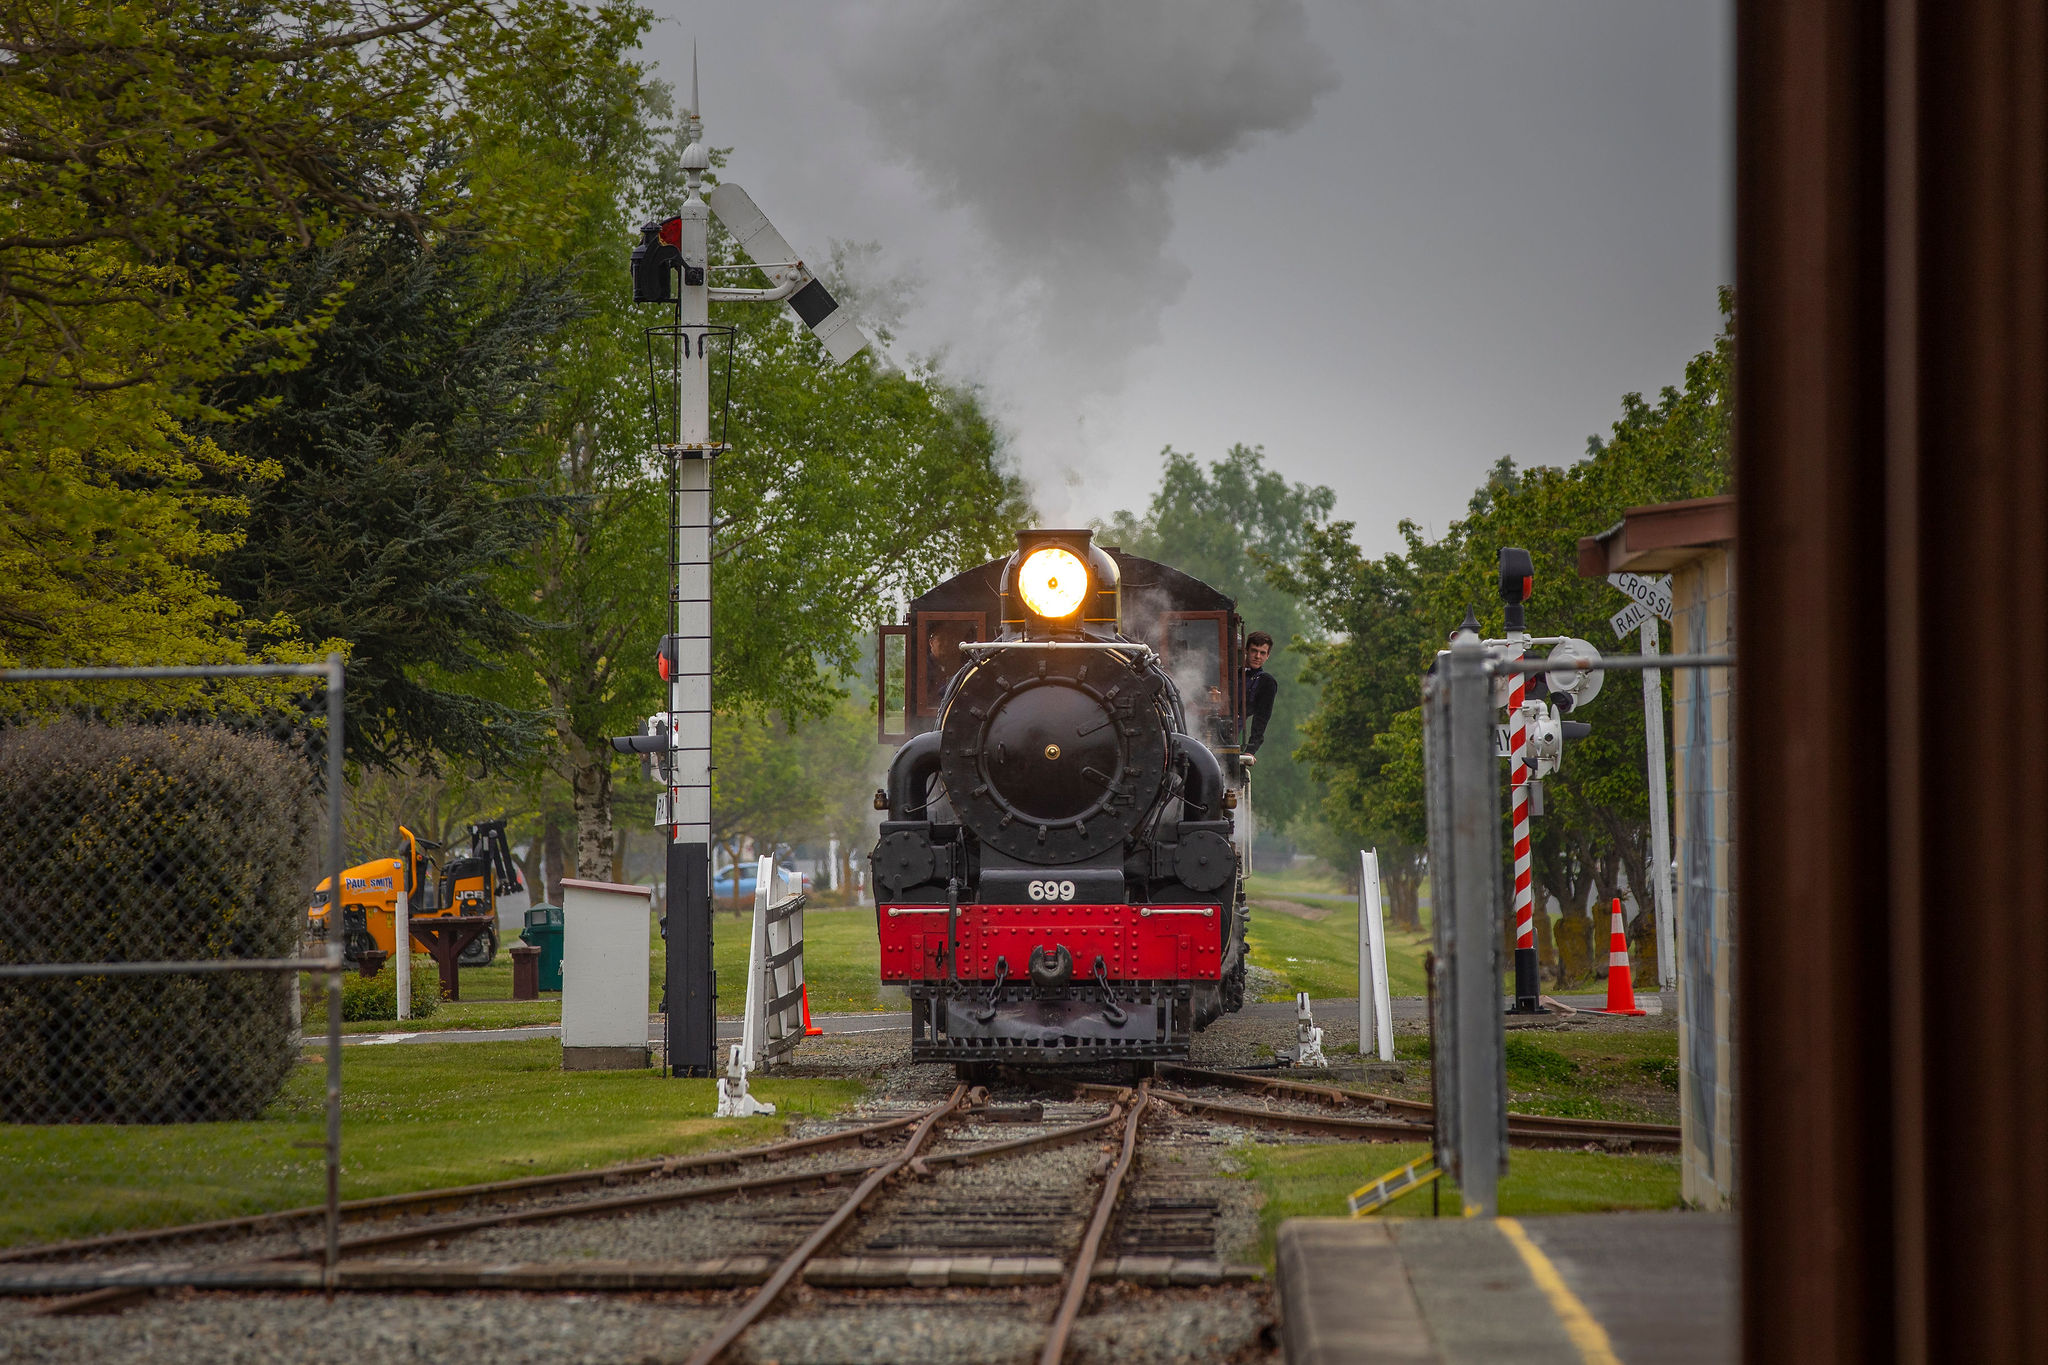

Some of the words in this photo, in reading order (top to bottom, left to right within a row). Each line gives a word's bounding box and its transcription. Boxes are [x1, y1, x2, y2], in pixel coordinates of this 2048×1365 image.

[1619, 572, 1672, 620] CROSSI
[1616, 605, 1645, 633] RAIL
[346, 878, 368, 890] PAUL
[370, 876, 393, 889] SMITH
[1028, 880, 1075, 901] 699
[456, 890, 484, 900] JCB
